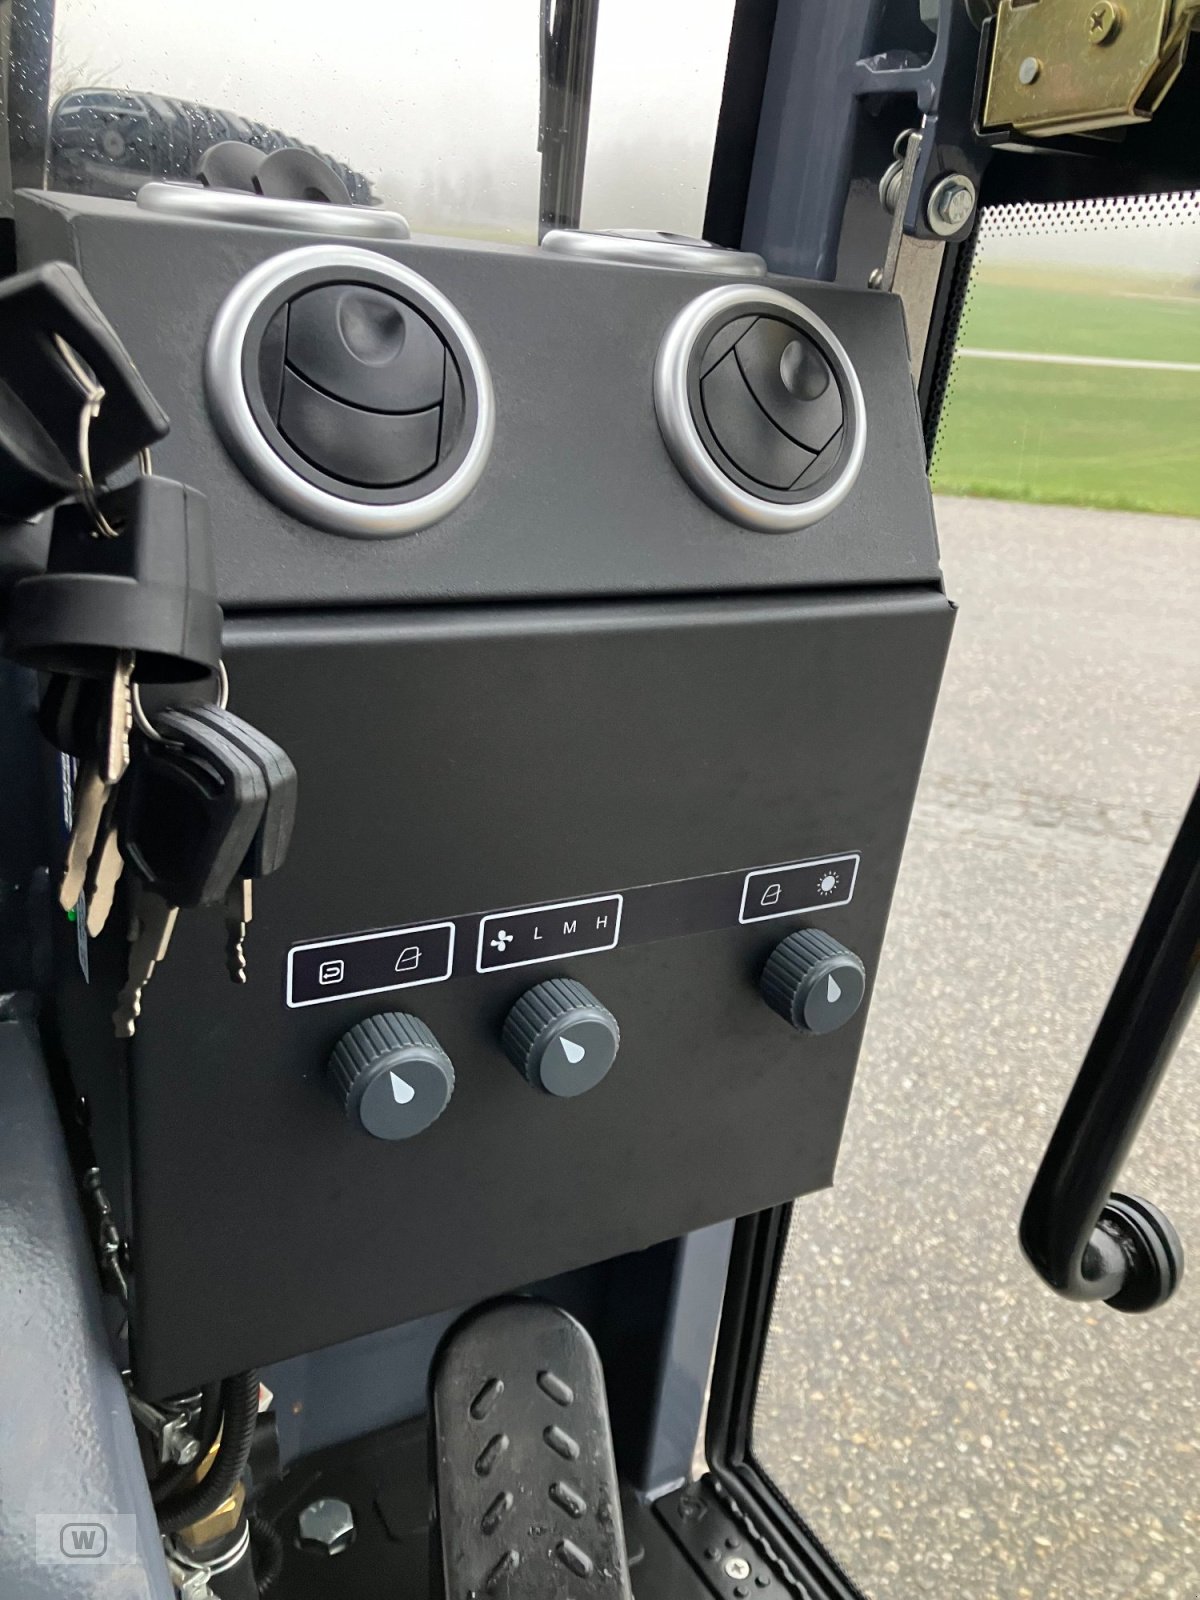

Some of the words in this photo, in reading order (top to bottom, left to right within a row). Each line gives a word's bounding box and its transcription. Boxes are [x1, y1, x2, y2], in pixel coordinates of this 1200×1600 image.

[533, 926, 543, 940] L
[563, 920, 577, 934] M
[596, 915, 608, 929] H
